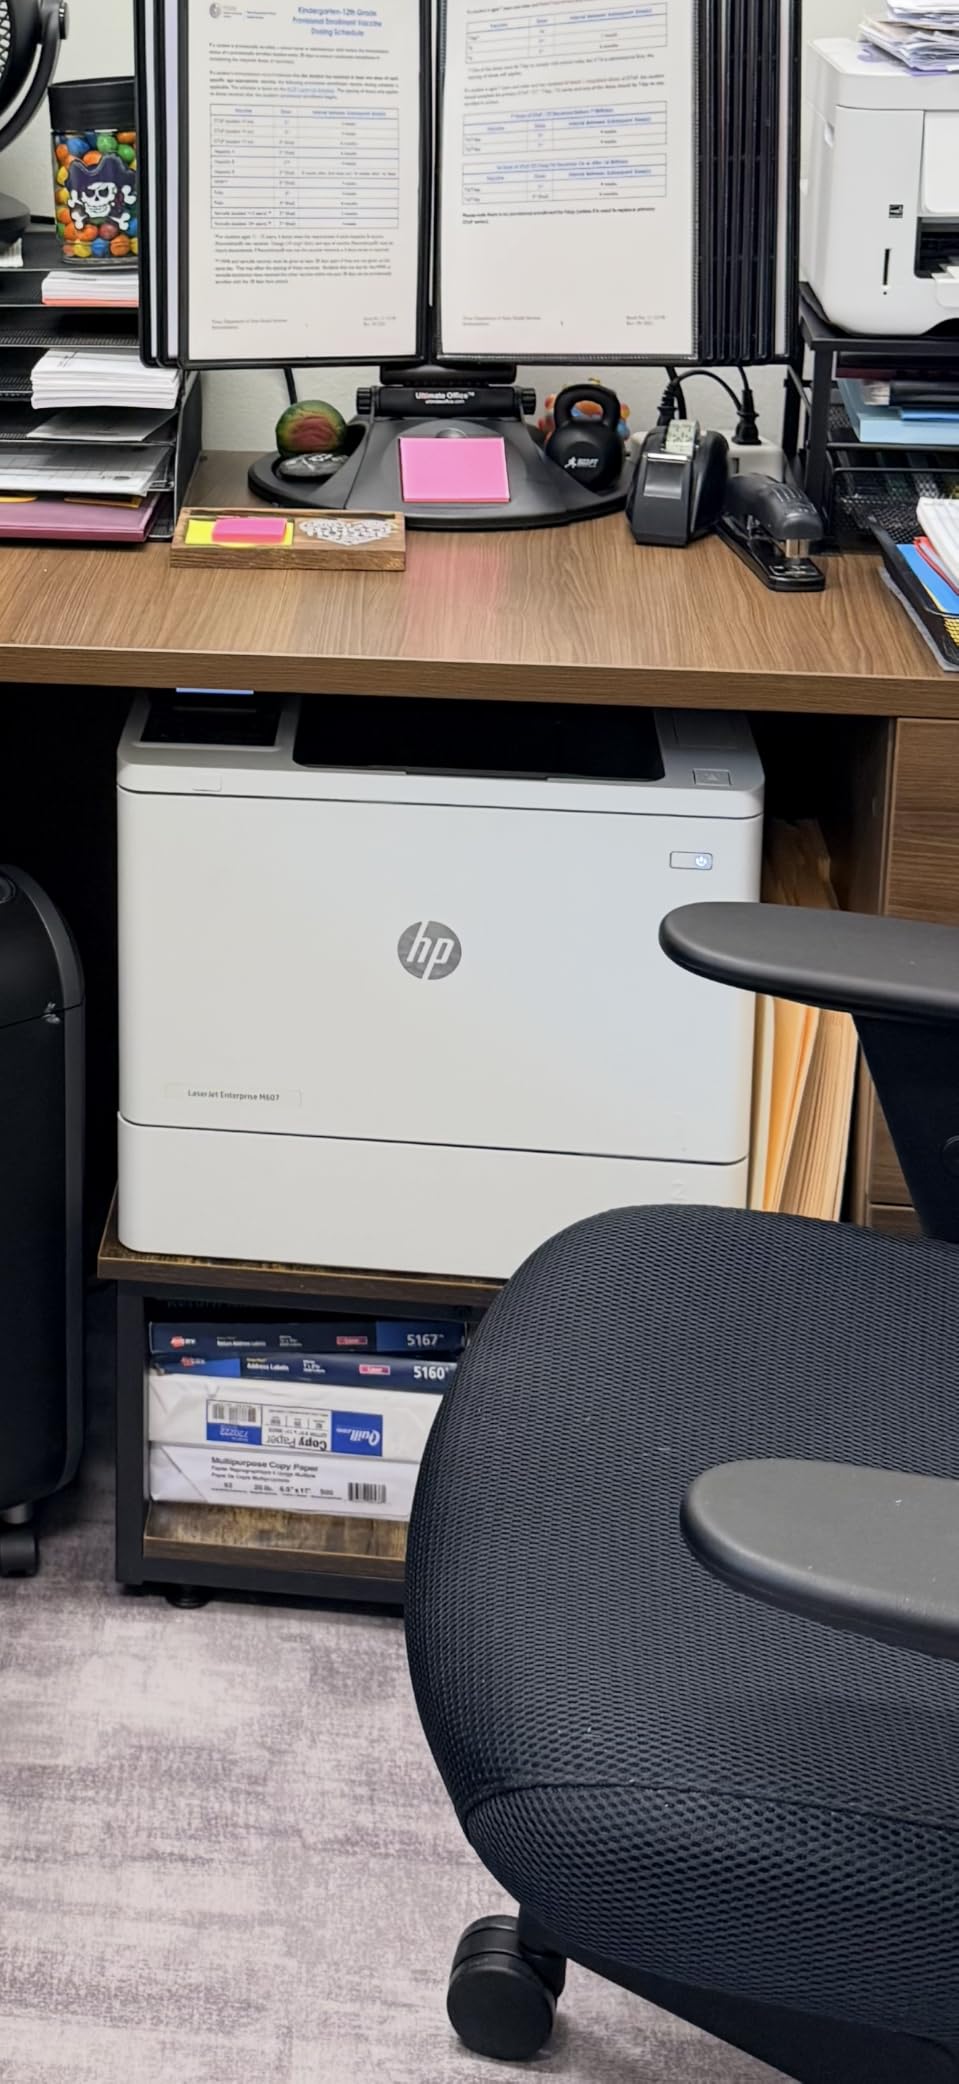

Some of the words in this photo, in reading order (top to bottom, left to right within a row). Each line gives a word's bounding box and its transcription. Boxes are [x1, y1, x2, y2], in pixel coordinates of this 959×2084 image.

[415, 391, 446, 400] Ultimate
[403, 920, 458, 980] hp
[187, 1089, 219, 1098] LaserJet
[220, 1091, 258, 1101] Enterprise
[259, 1093, 280, 1101] M607
[407, 1334, 439, 1347] 5167
[246, 1363, 269, 1371] Address
[413, 1365, 445, 1380] 5160
[298, 1438, 328, 1452] Copy
[211, 1456, 268, 1469] Multipurpose
[269, 1462, 291, 1471] Copy
[293, 1463, 318, 1472] Paper
